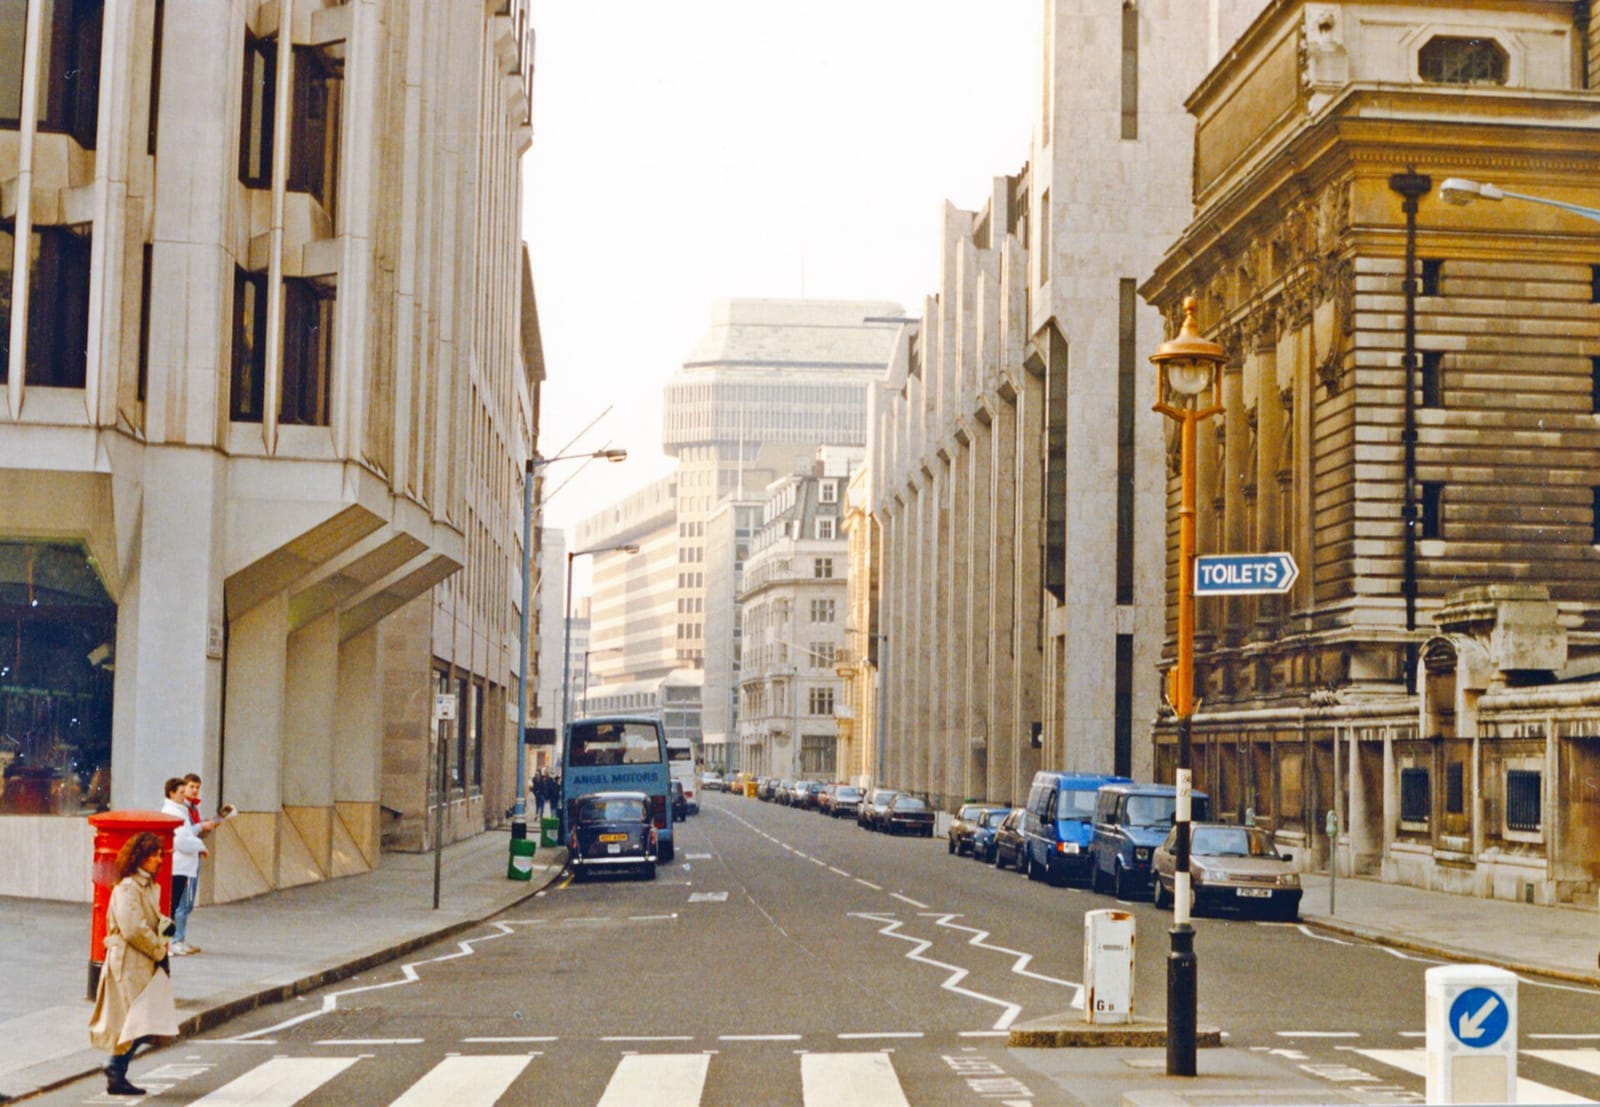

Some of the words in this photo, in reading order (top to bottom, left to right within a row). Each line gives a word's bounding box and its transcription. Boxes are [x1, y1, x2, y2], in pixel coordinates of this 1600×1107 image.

[1201, 562, 1278, 585] TOILETS
[573, 773, 609, 785] ANGEL
[611, 772, 659, 784] MOTORS
[1096, 999, 1105, 1012] G
